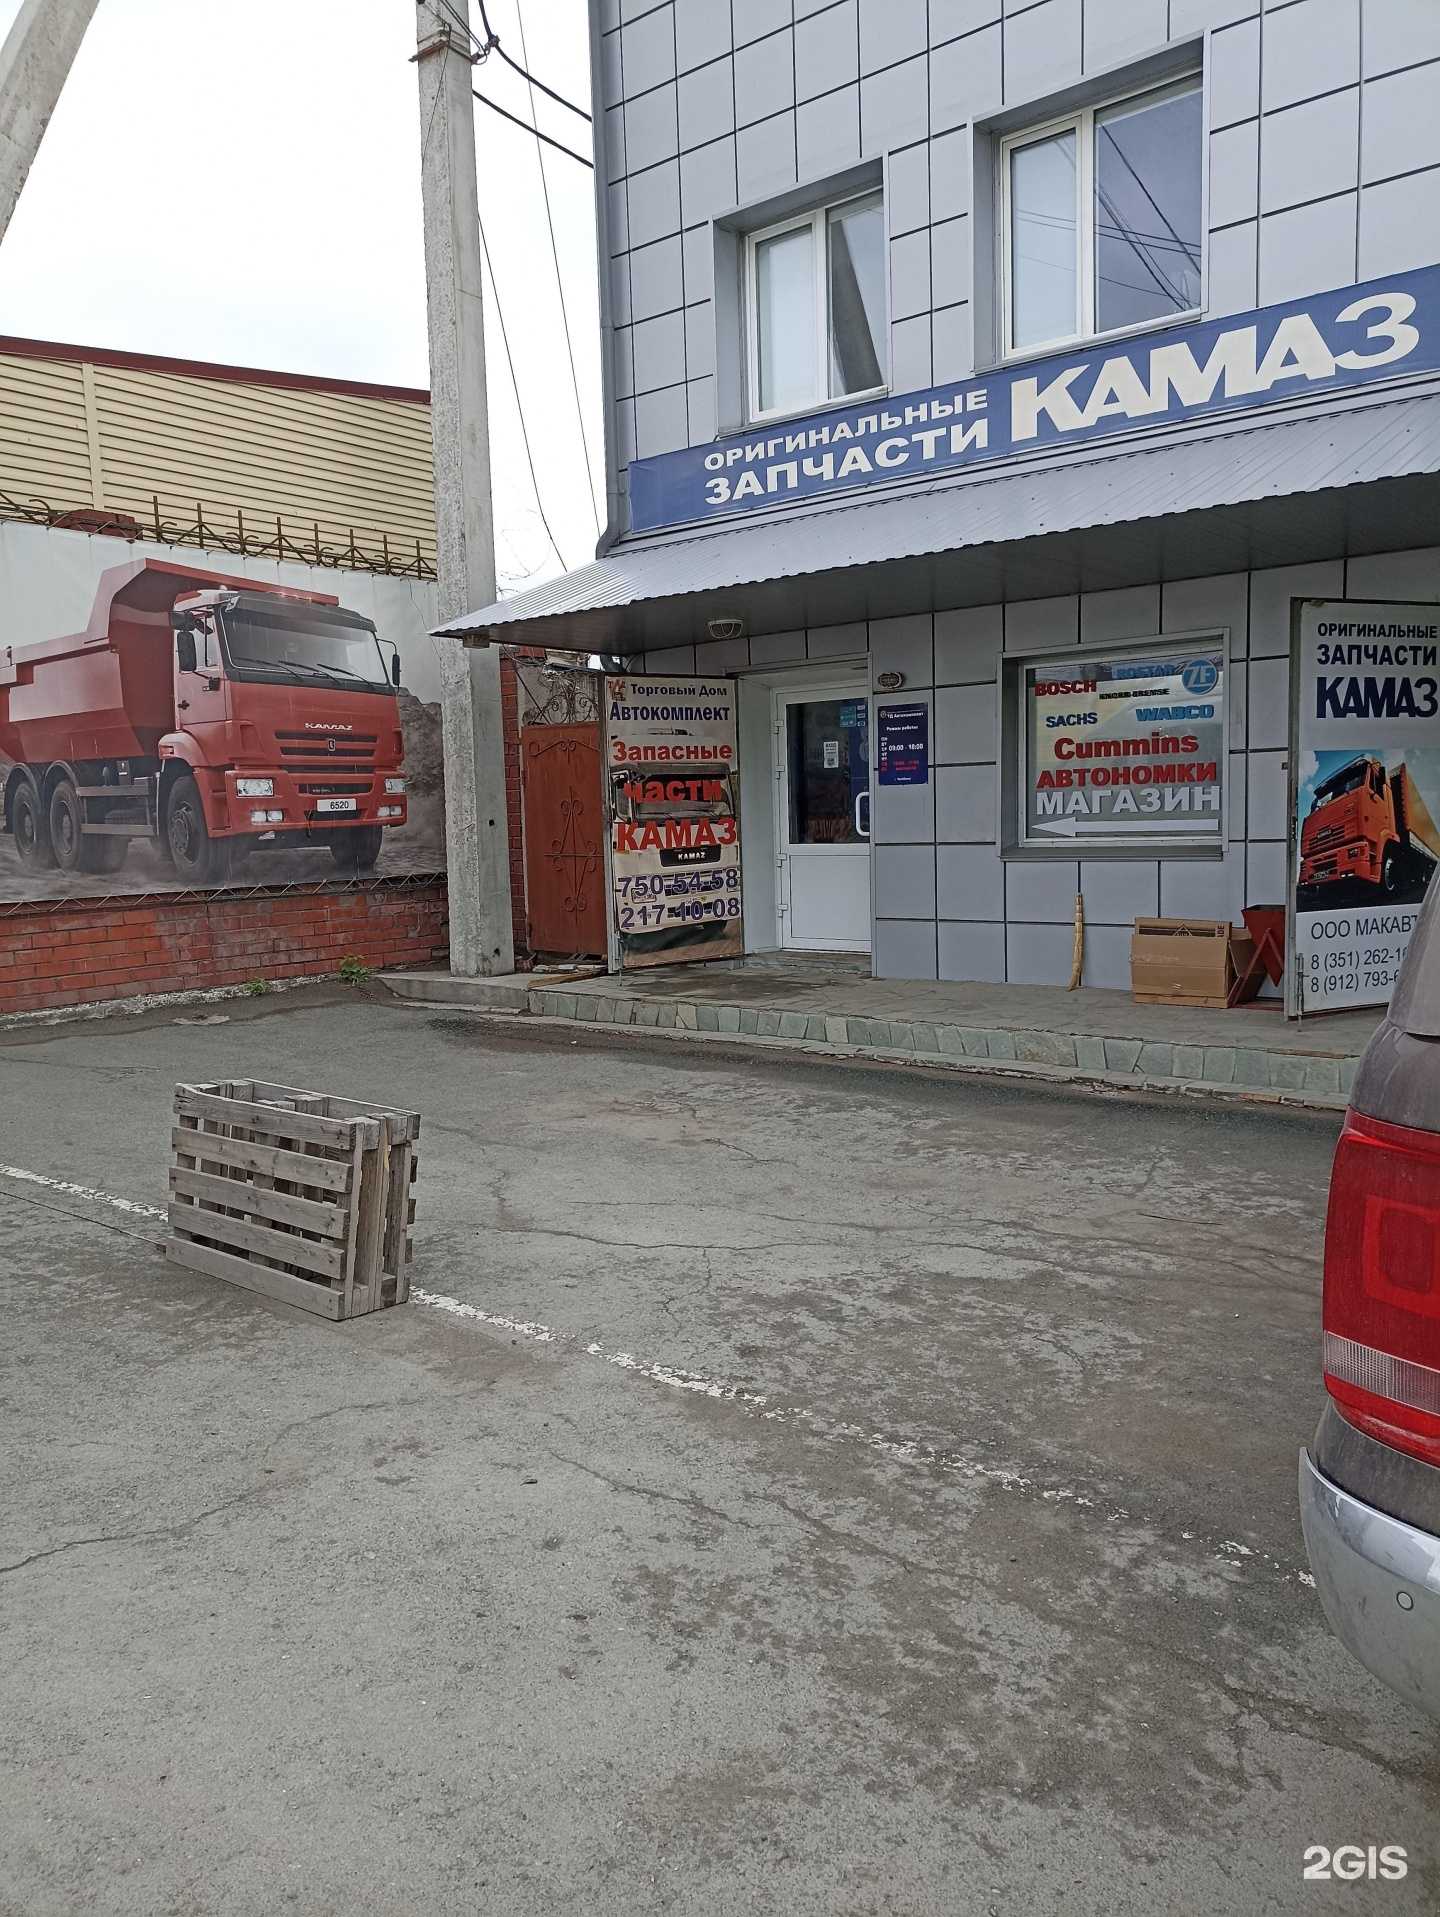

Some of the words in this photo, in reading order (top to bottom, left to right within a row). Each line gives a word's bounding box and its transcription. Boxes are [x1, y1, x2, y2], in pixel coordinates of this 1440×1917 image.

[1011, 292, 1420, 442] КАМАЗ
[703, 389, 989, 472] ОРИГИНАЛЬНЫЕ
[703, 418, 989, 506] ЗАПЧАСТИ
[1317, 623, 1438, 639] ОРИГИНАЛЬНЫЕ
[1316, 644, 1438, 666] ЗАПЧАСТИ
[631, 684, 695, 697] Торговый
[699, 683, 727, 698] Дом
[1034, 680, 1097, 697] BOSCH
[1315, 676, 1439, 720] КАМАЗ
[610, 702, 730, 722] Автокомплект
[1046, 712, 1098, 728] SACHS
[1135, 704, 1215, 722] WABCO
[613, 741, 733, 762] Запасные
[1054, 732, 1200, 760] Cummins
[1036, 762, 1217, 789] АВТОНОМКИ
[623, 780, 722, 804] части
[1036, 786, 1221, 816] МАГАЗИН
[330, 800, 349, 810] 6520
[616, 818, 737, 852] КАМАЗ
[677, 852, 706, 860] KAMAZ
[618, 868, 739, 898] 750-54-58
[620, 897, 740, 930] 217-10-08
[1311, 920, 1351, 940] ООО
[1311, 955, 1320, 970] 8
[1323, 951, 1360, 971] (351)
[1311, 977, 1320, 993] 8
[1323, 973, 1359, 994] (912)
